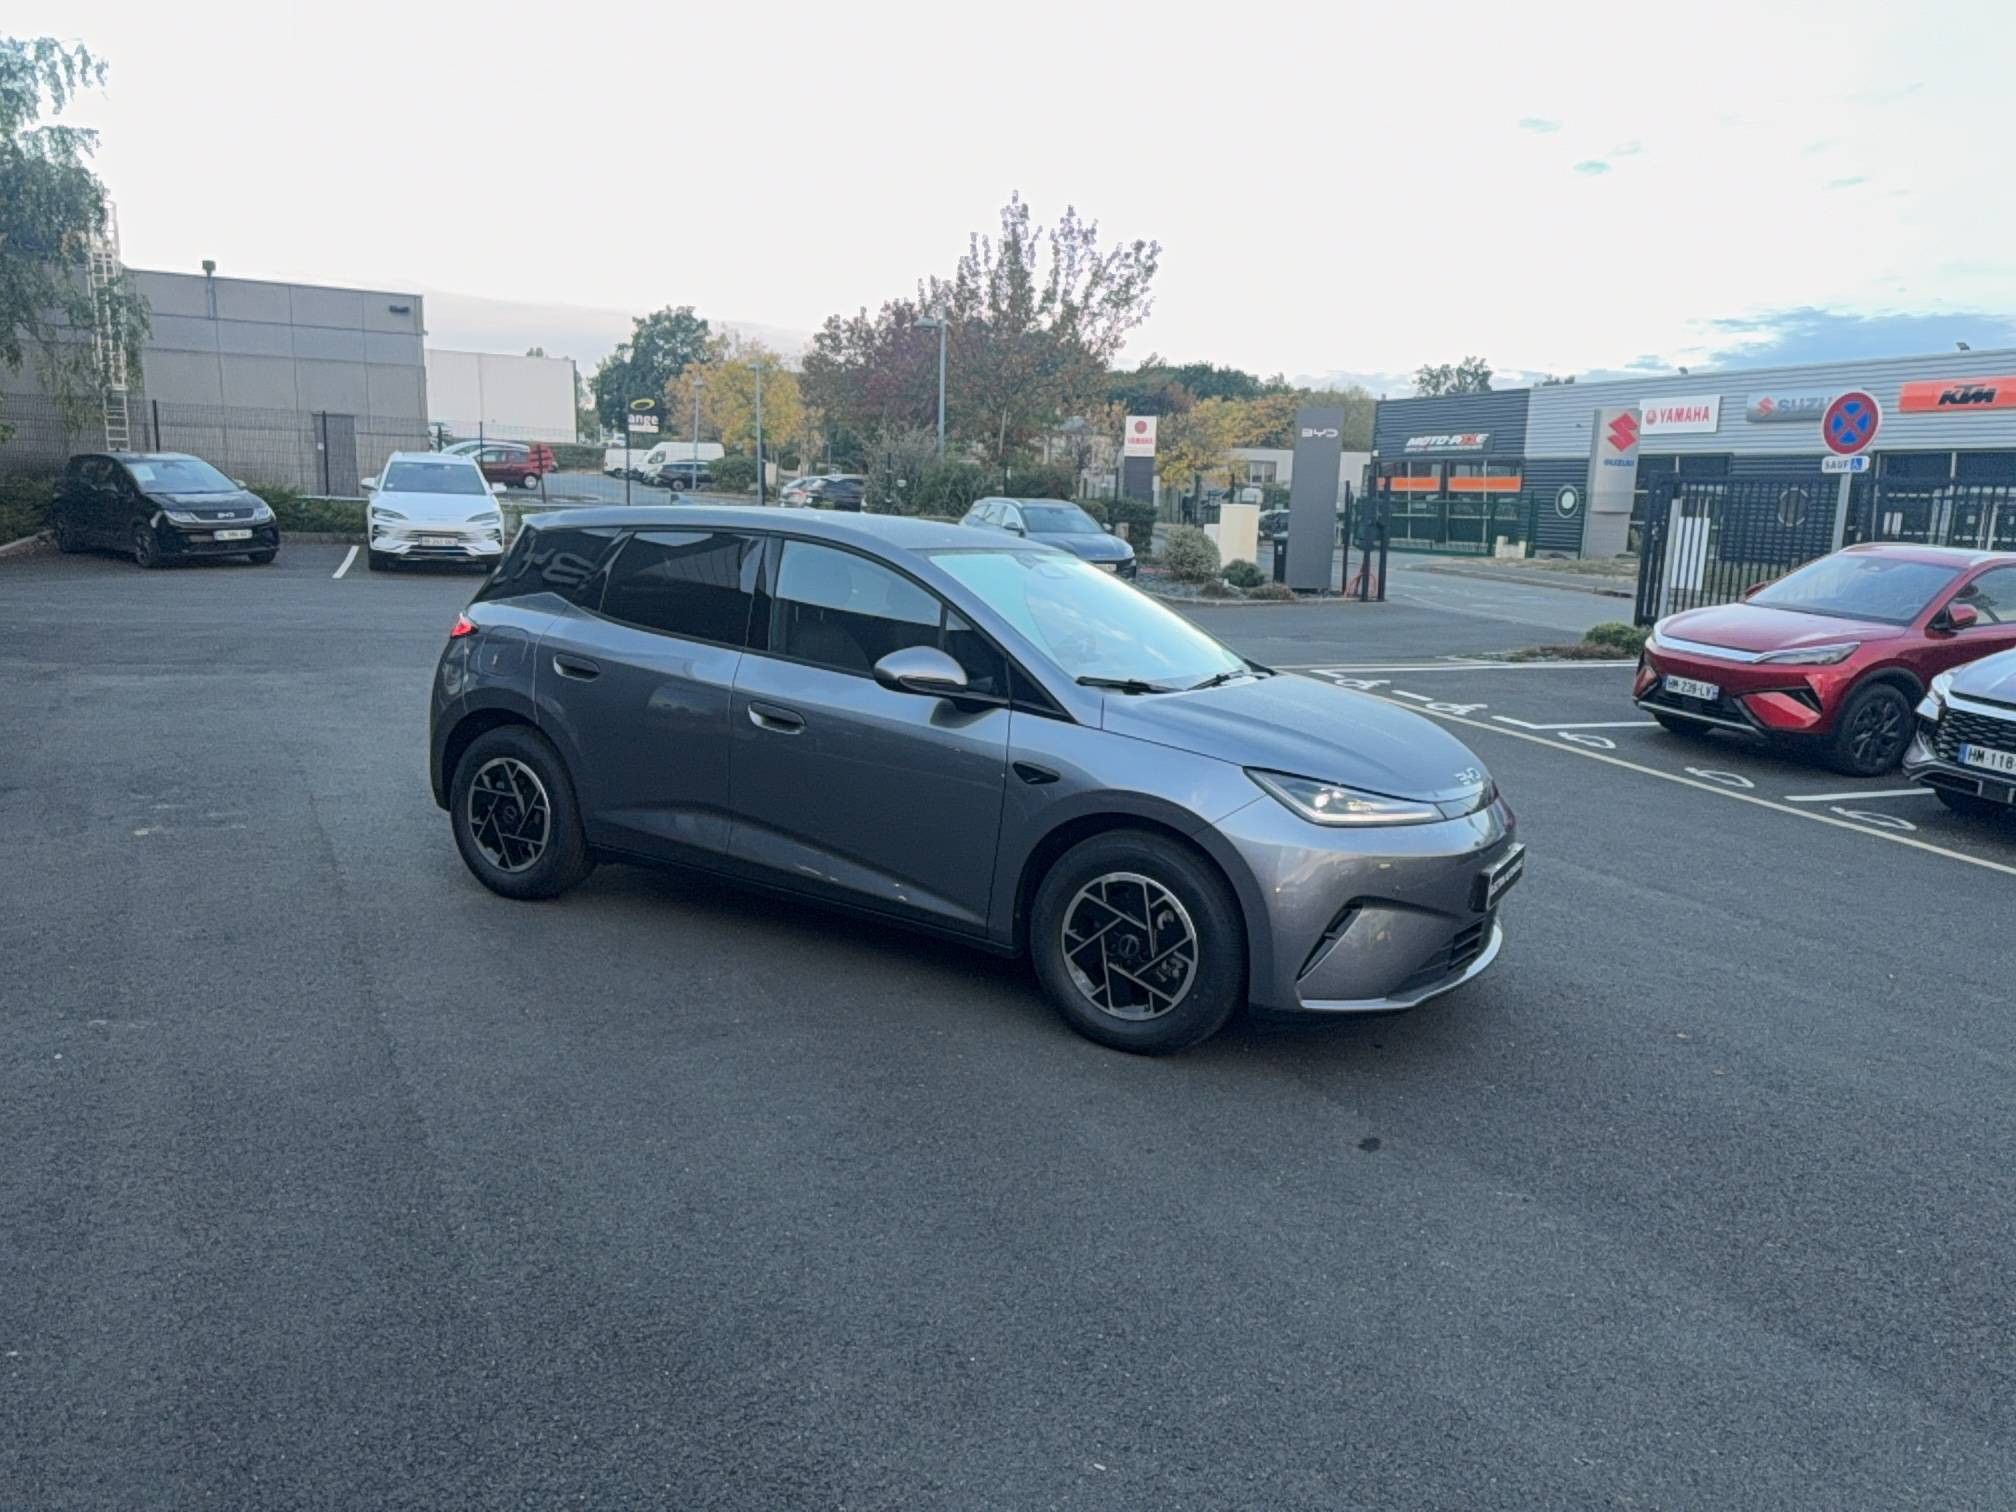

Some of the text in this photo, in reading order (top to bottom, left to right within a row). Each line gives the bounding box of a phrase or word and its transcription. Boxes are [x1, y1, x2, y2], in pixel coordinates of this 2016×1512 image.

[1938, 384, 1996, 405] KTM
[1778, 397, 1832, 414] SUZU
[1660, 406, 1709, 424] YAMAHA
[1302, 428, 1338, 438] BYD
[1824, 460, 1848, 470] SAUF
